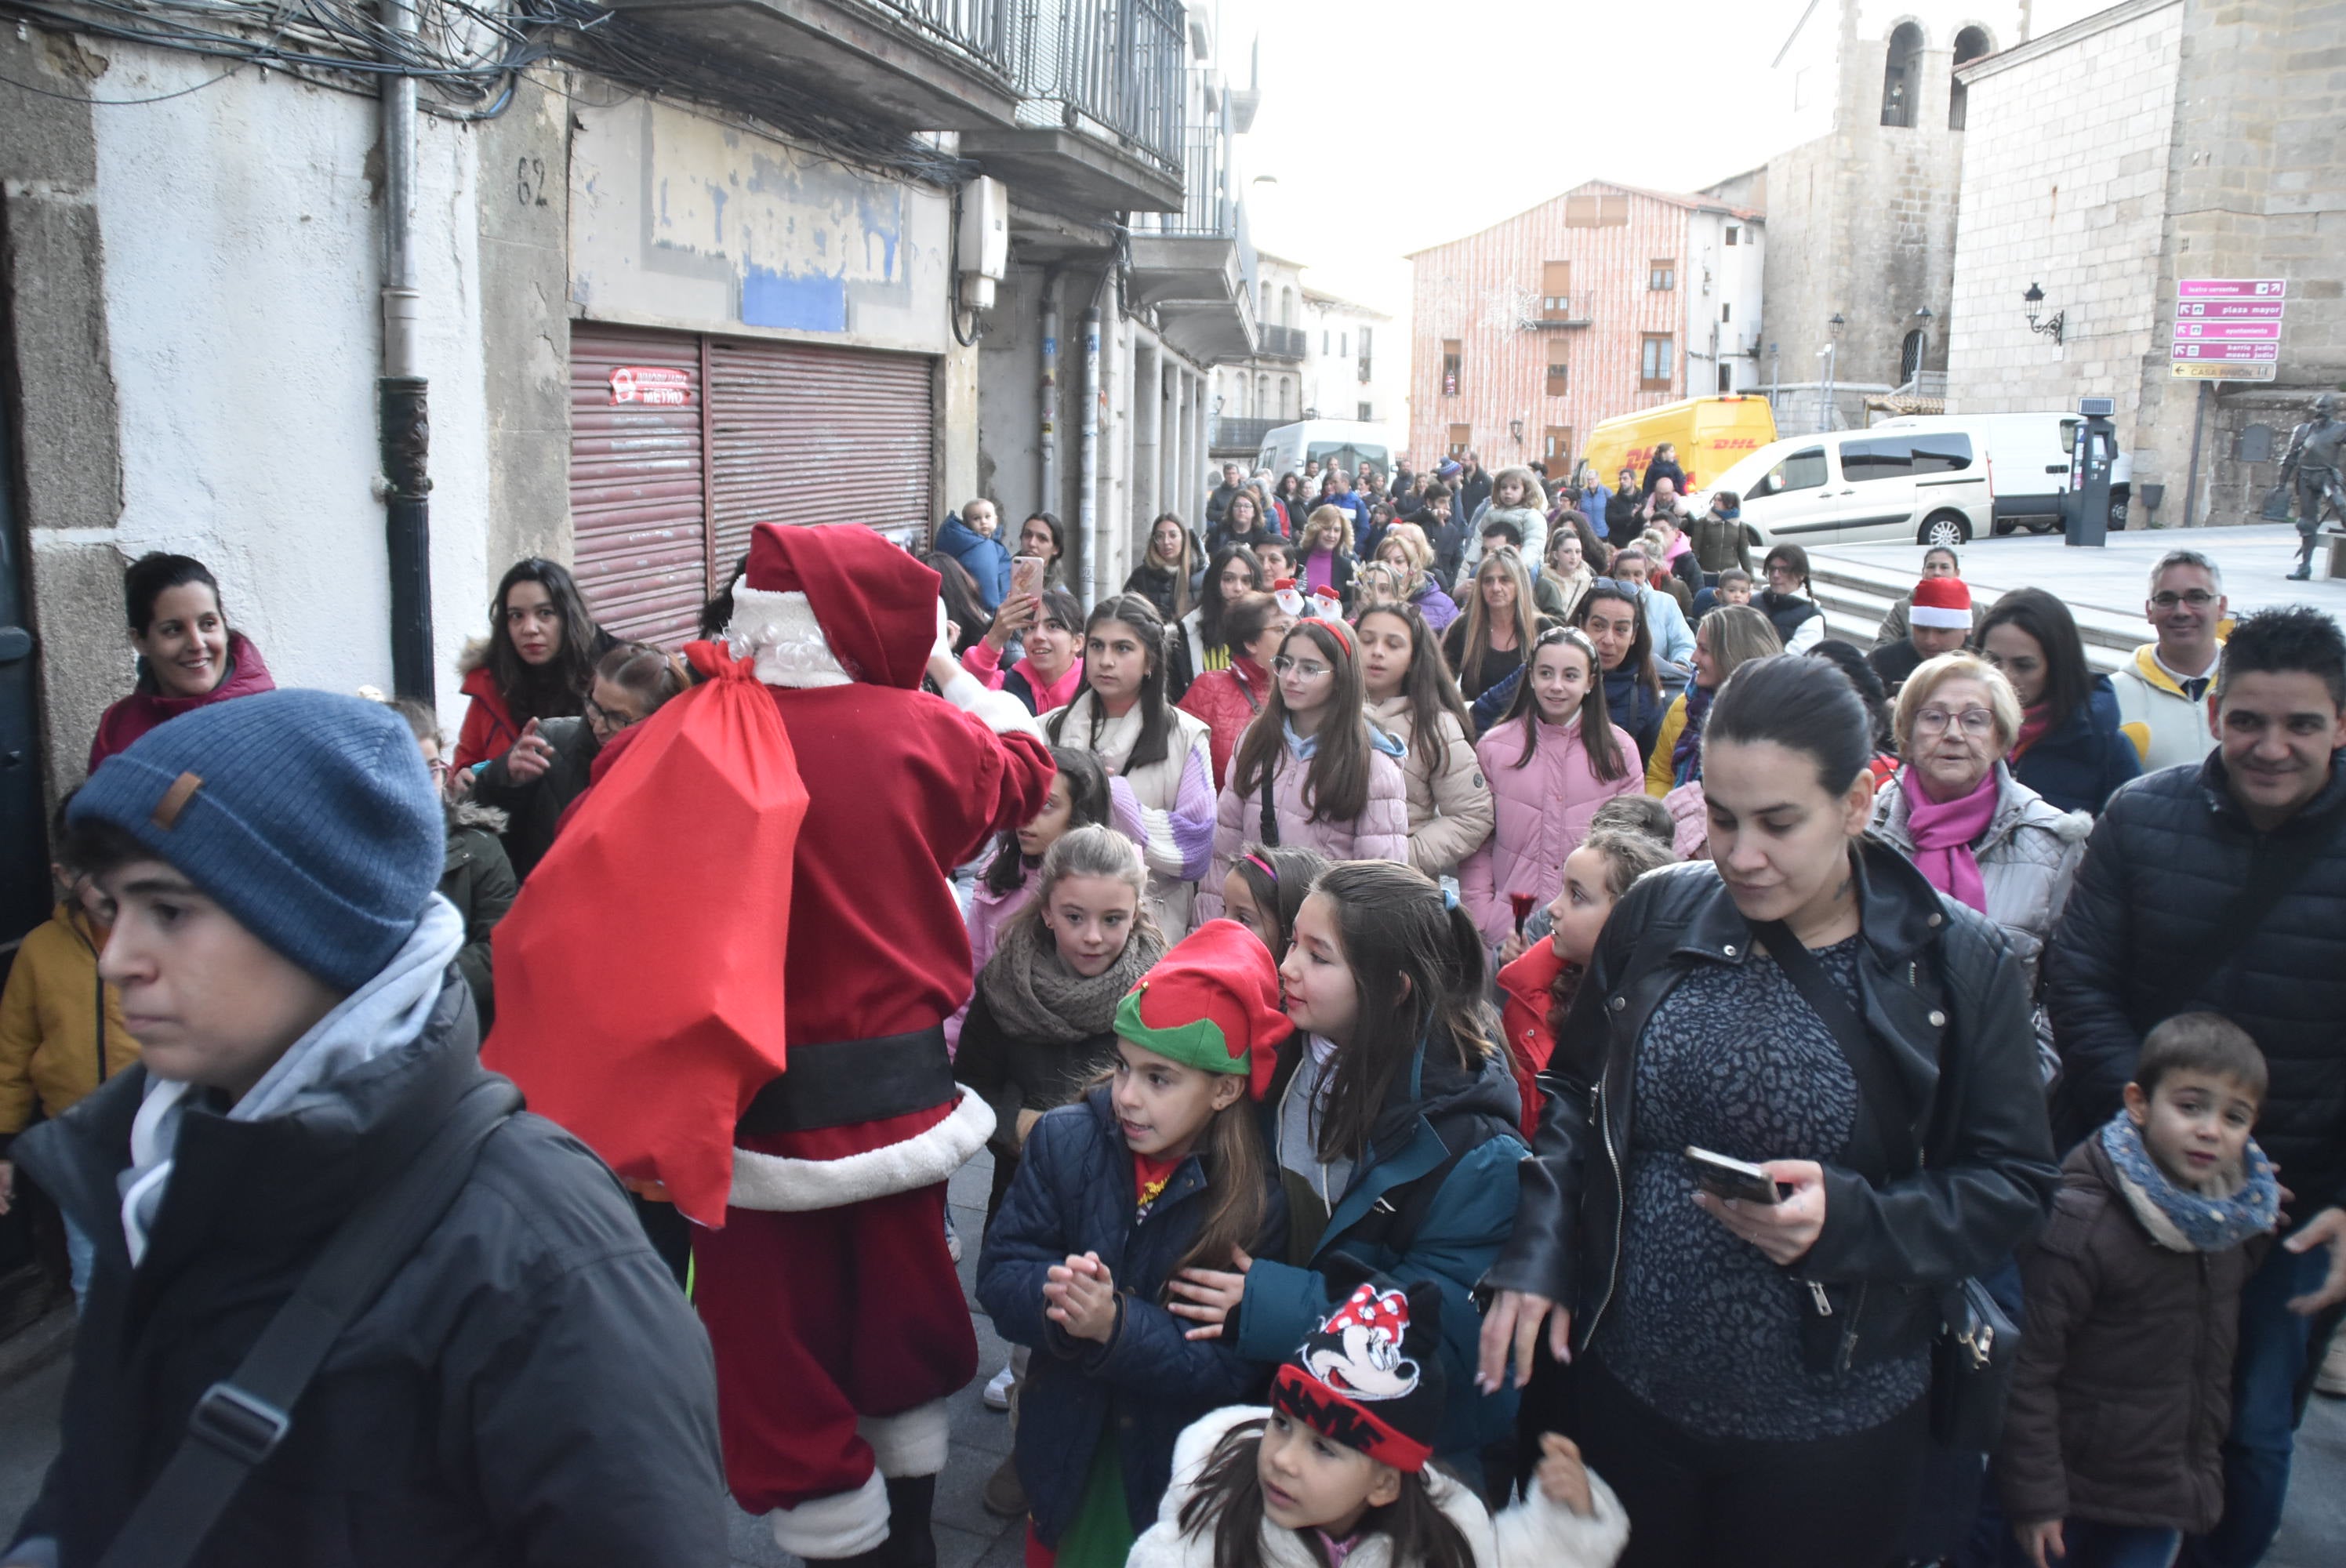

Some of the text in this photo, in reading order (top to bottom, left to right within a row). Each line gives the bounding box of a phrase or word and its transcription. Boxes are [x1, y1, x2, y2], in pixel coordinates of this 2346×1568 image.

[518, 157, 547, 206] 62
[643, 388, 683, 404] METRO
[1714, 439, 1756, 449] DHL
